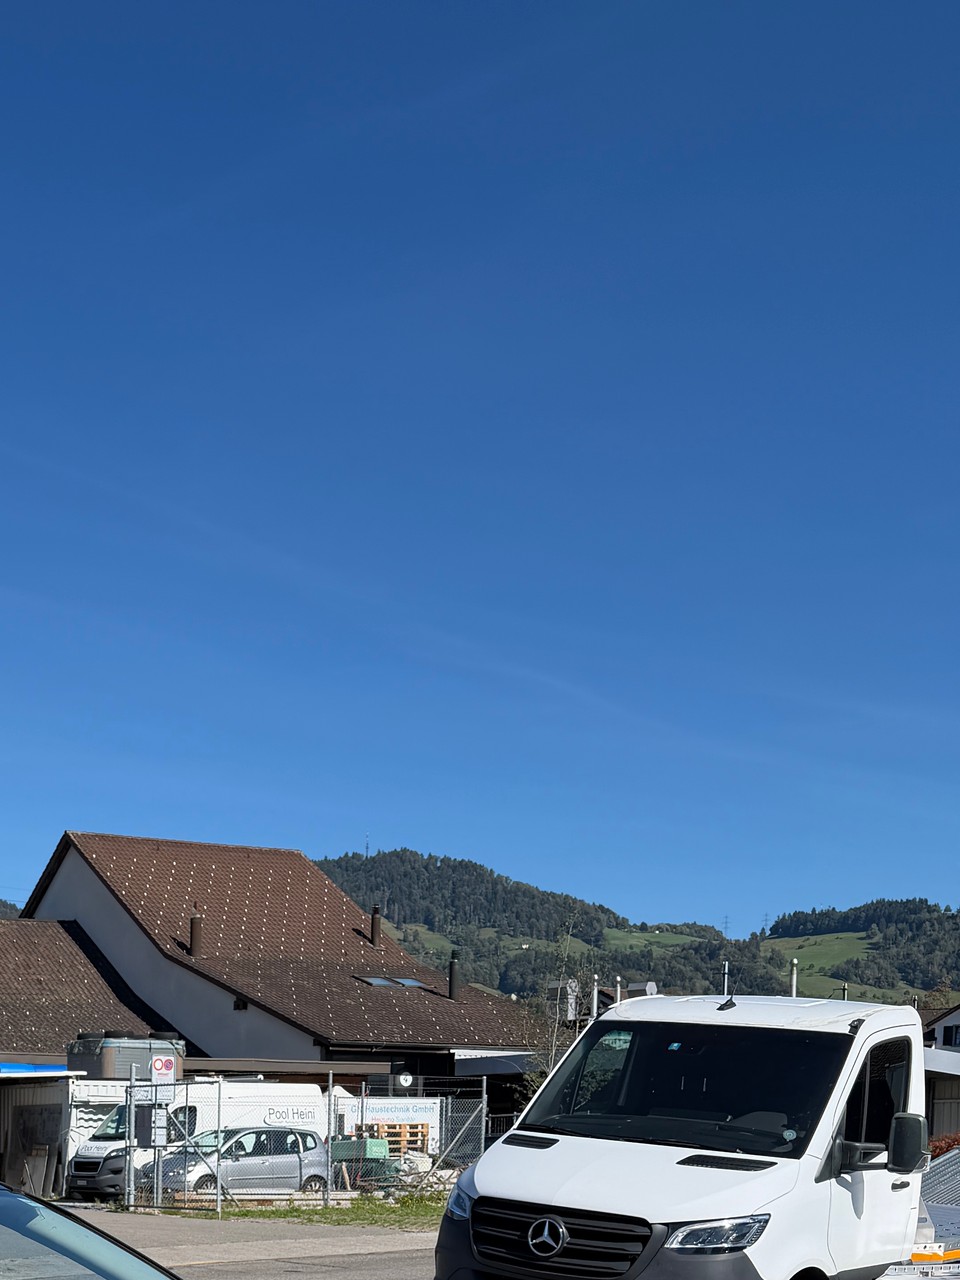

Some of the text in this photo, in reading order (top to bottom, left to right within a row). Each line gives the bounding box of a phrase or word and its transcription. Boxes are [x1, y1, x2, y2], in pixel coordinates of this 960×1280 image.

[268, 1107, 316, 1120] Pool Heini
[412, 1105, 434, 1113] GmbH
